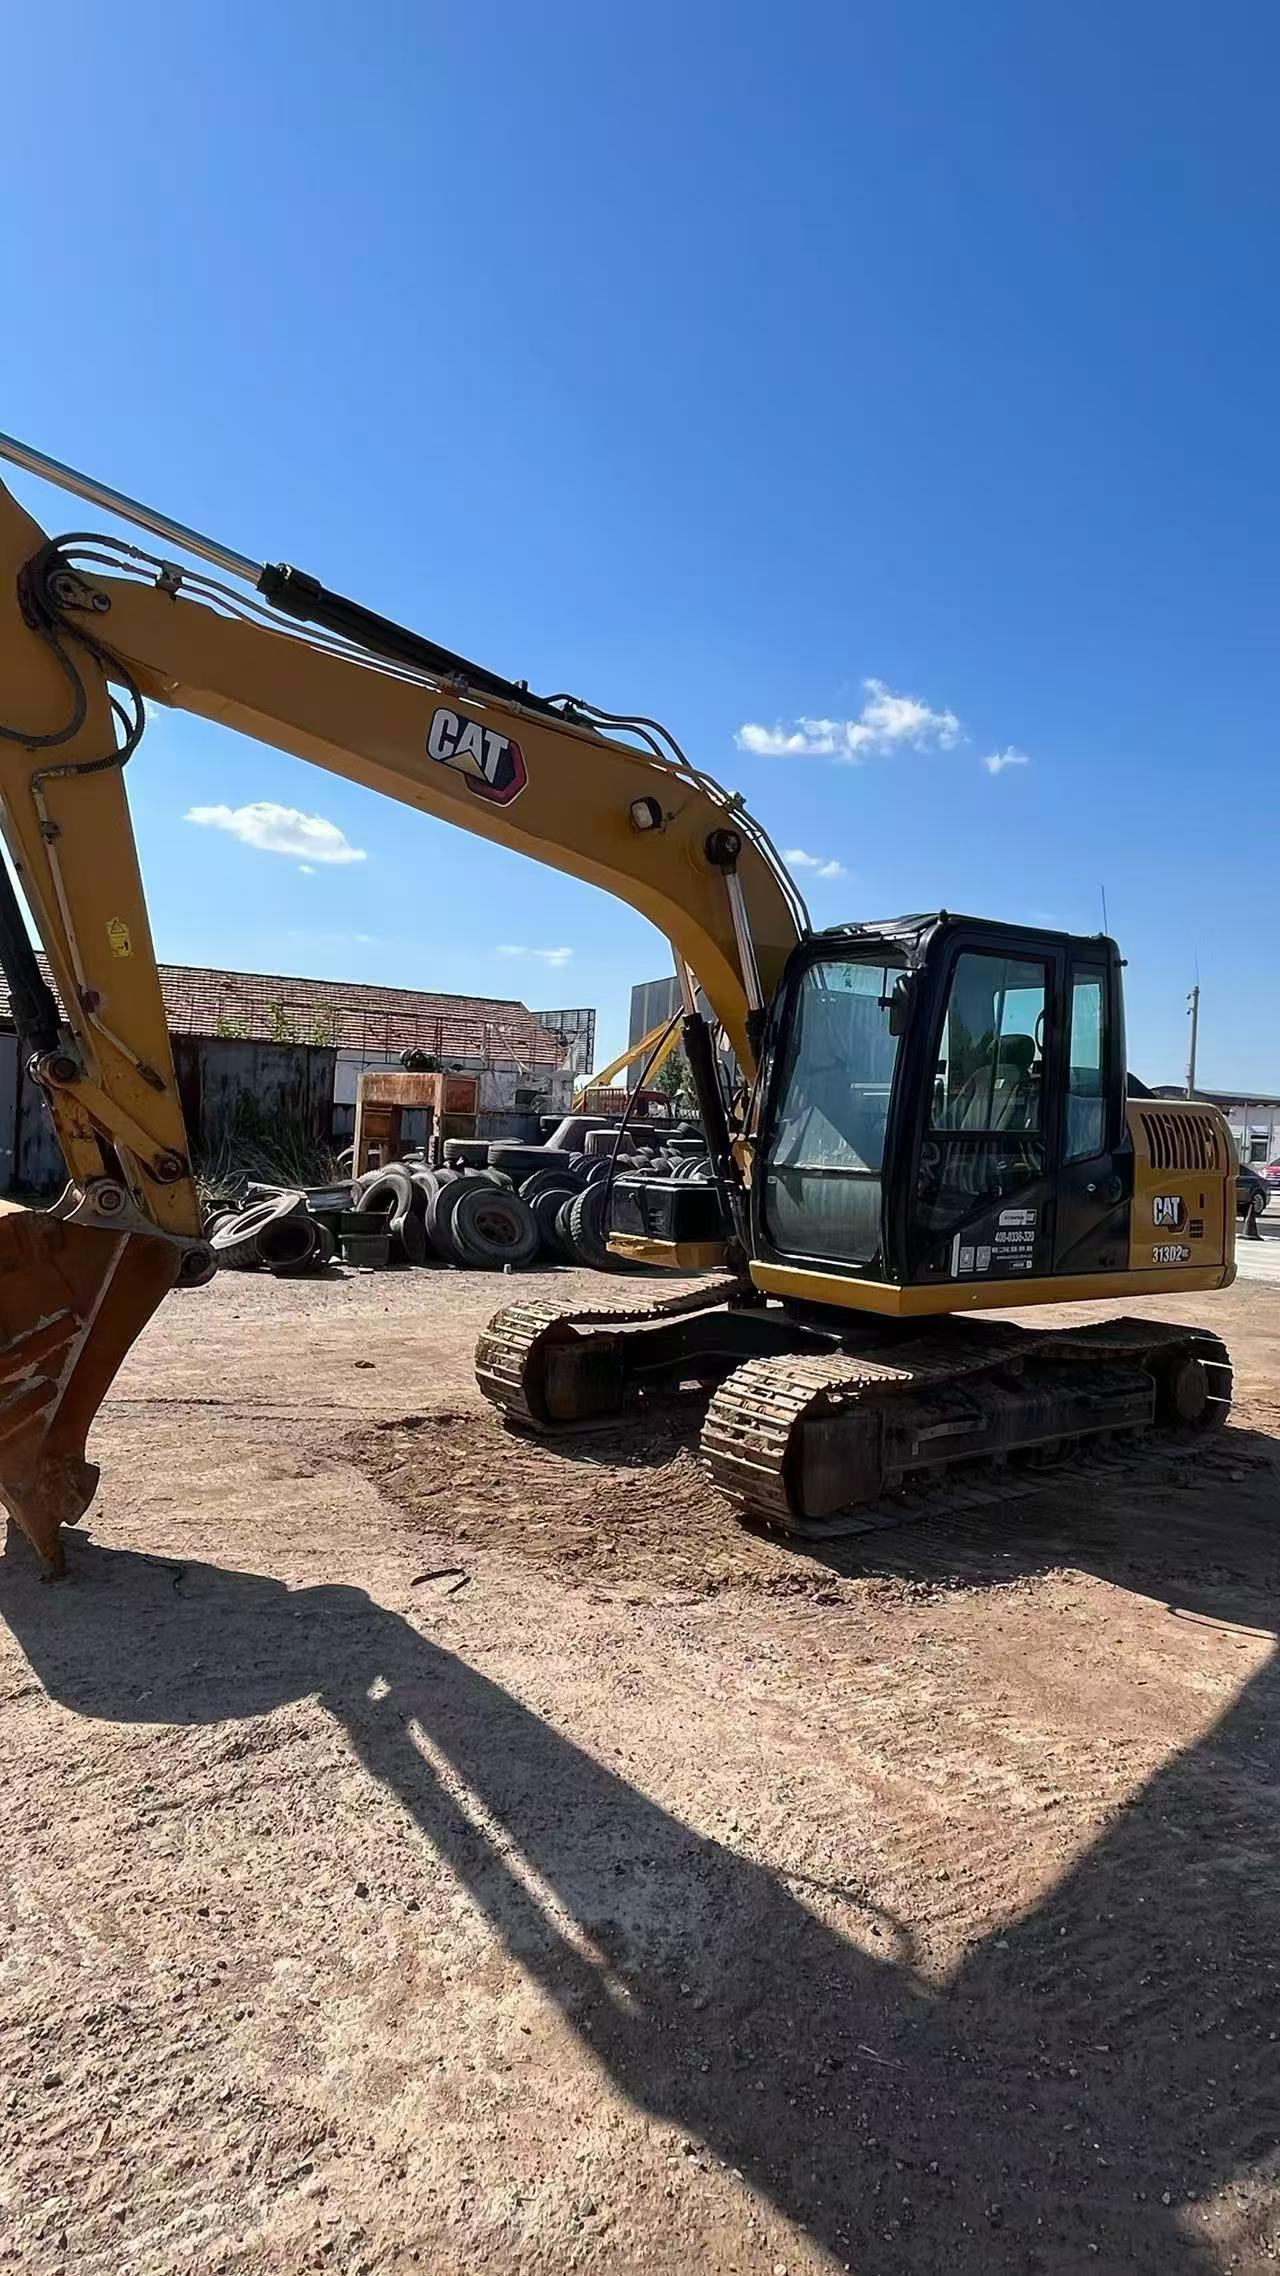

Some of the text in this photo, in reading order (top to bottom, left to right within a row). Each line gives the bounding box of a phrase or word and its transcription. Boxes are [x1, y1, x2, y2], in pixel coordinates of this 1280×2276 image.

[428, 708, 509, 784] CAT
[1153, 1197, 1180, 1226] CAT
[1152, 1245, 1182, 1263] 313D2
